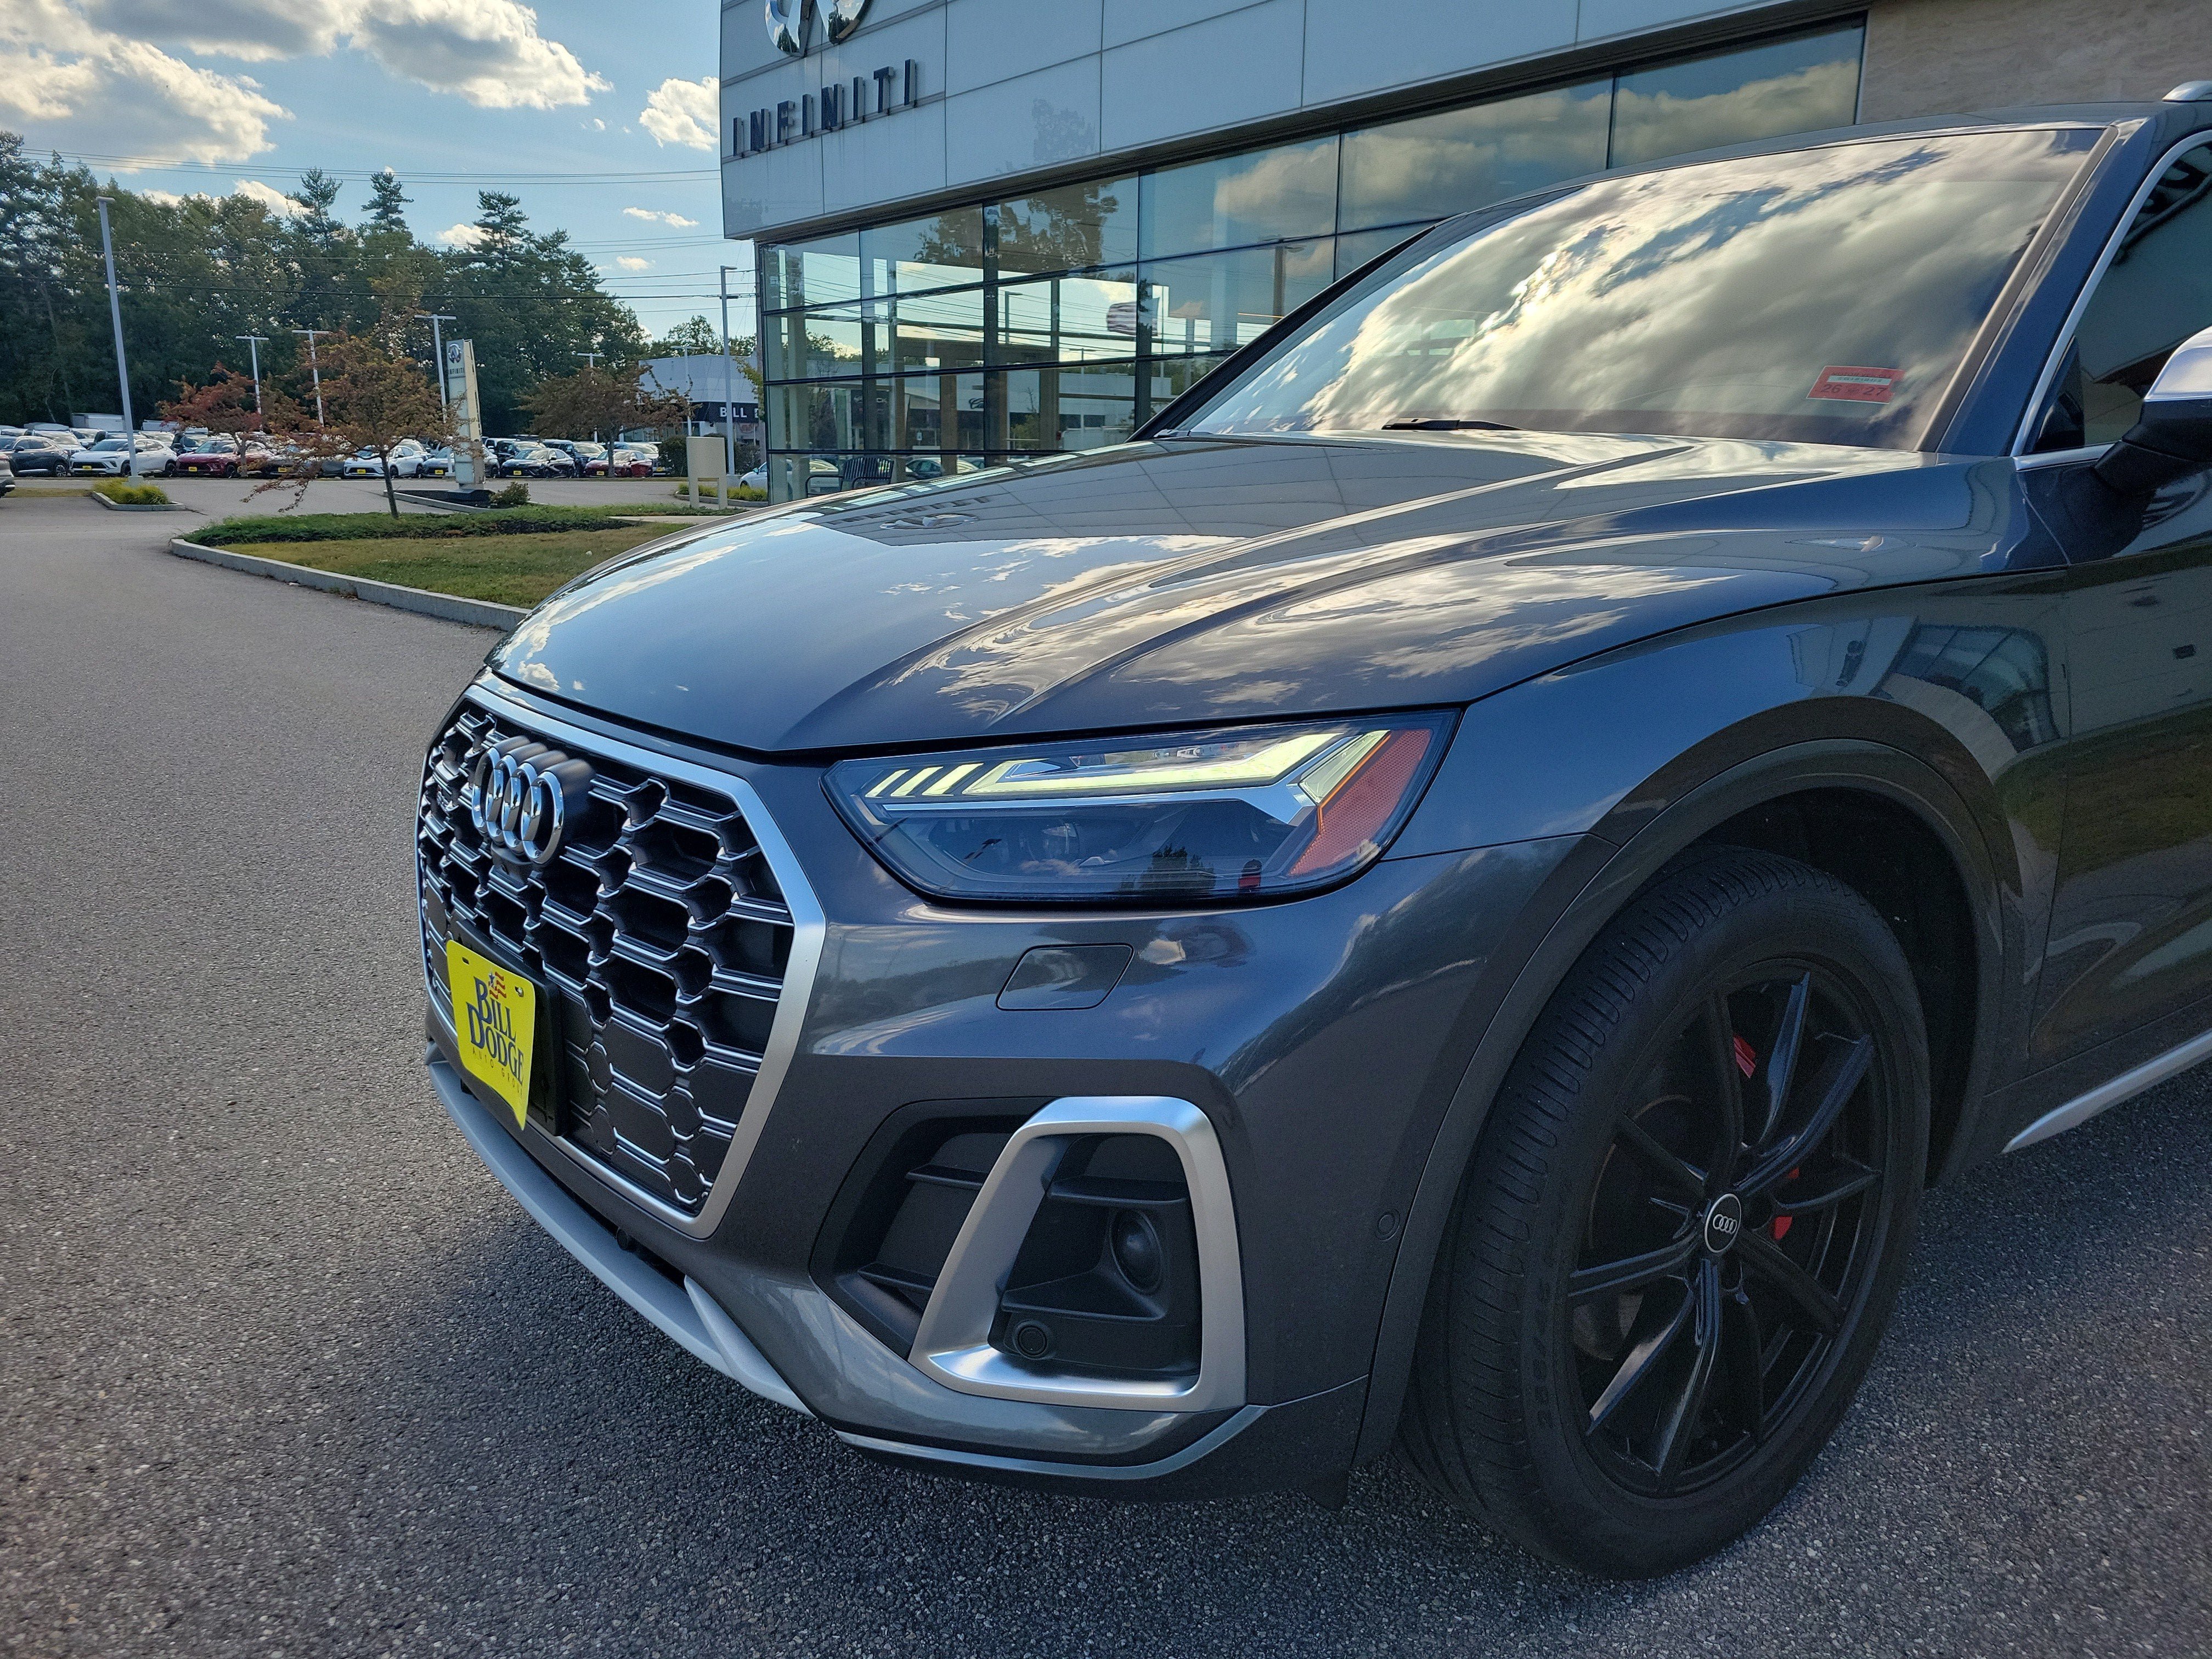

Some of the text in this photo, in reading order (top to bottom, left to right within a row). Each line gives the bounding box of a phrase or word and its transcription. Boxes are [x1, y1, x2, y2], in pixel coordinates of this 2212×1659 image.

[733, 59, 917, 157] INFINITI
[719, 407, 747, 417] BLL
[1821, 384, 1888, 396] 26 27
[473, 976, 516, 1043] BILL
[466, 1002, 524, 1086] DODGE
